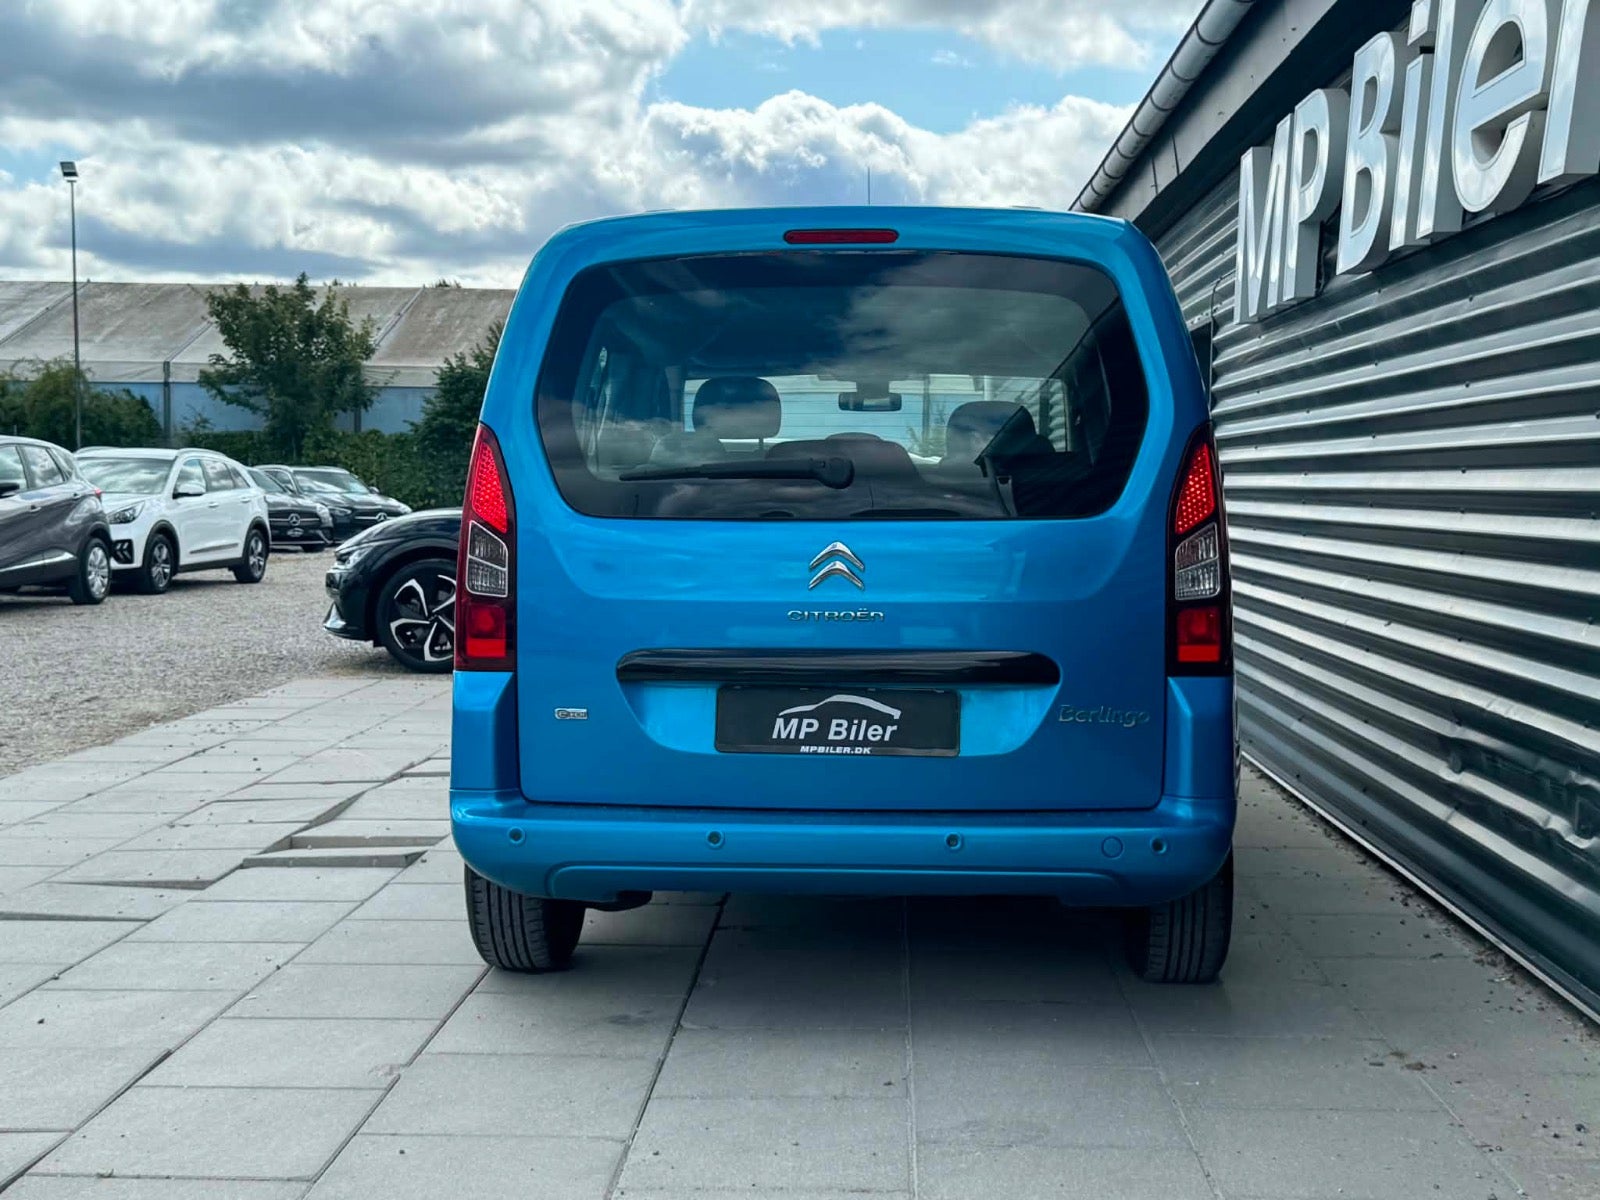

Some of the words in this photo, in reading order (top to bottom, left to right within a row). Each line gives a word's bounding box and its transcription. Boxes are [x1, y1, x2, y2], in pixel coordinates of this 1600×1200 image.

[1233, 88, 1332, 325] MP
[1058, 704, 1151, 728] Berlingo
[772, 717, 819, 740] MP
[827, 718, 898, 742] Biler
[799, 745, 872, 756] MPBILER.DK
